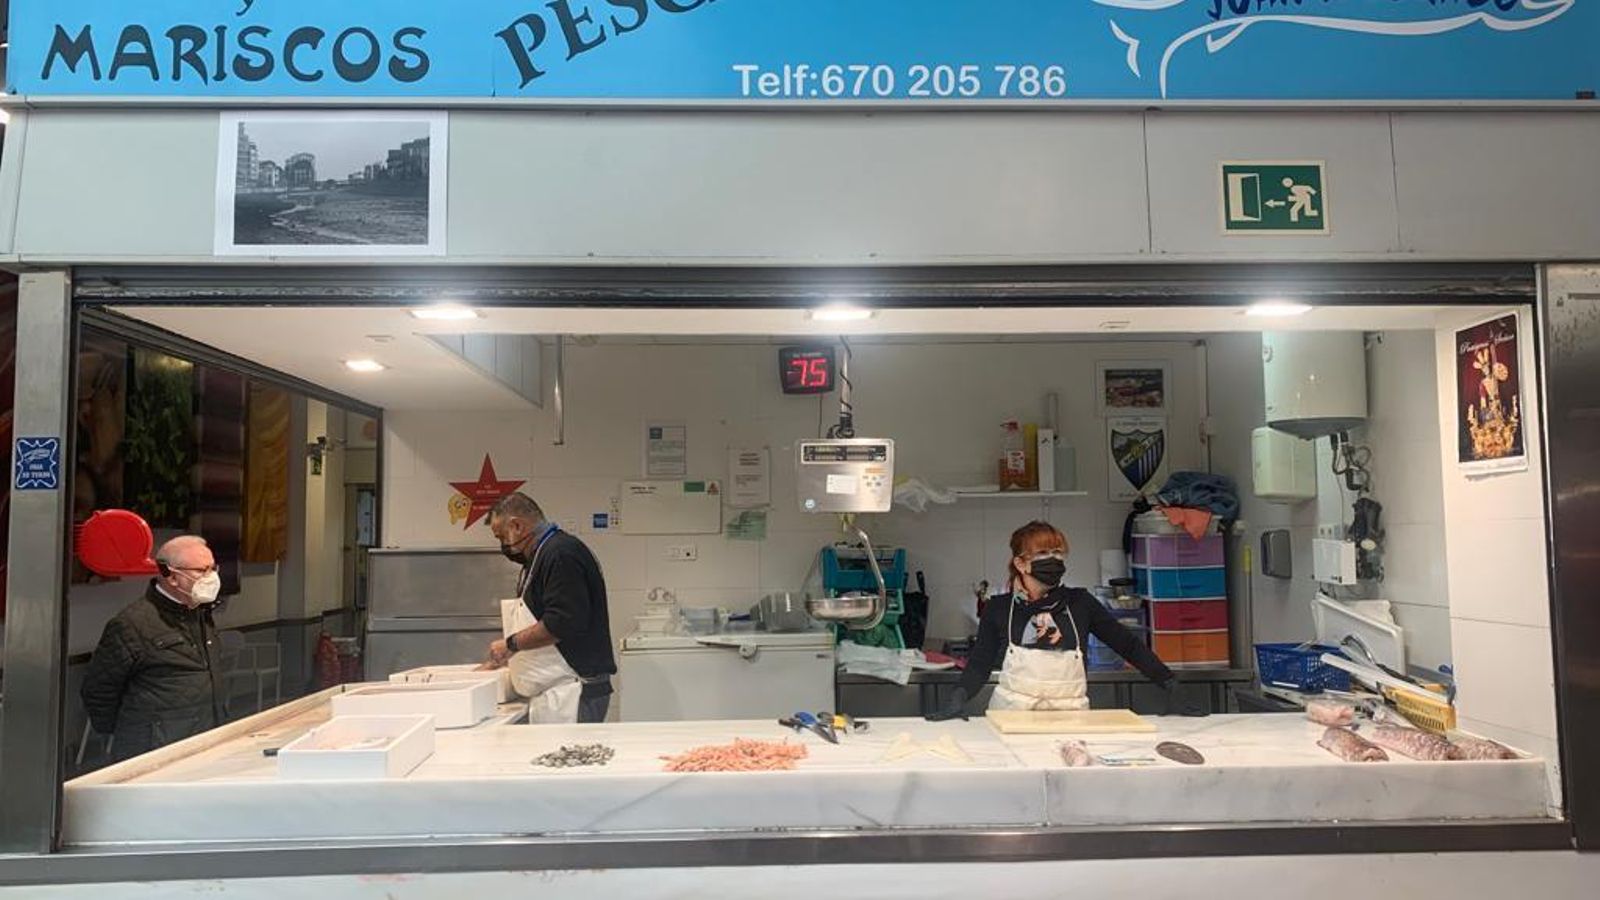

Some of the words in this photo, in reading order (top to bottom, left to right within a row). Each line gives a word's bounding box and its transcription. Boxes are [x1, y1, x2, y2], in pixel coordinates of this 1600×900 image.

[41, 24, 431, 86] MARISCOS
[494, 0, 706, 89] PES
[732, 64, 895, 97] Telf:670
[907, 64, 981, 97] 205
[994, 64, 1067, 97] 786
[792, 357, 827, 387] 75
